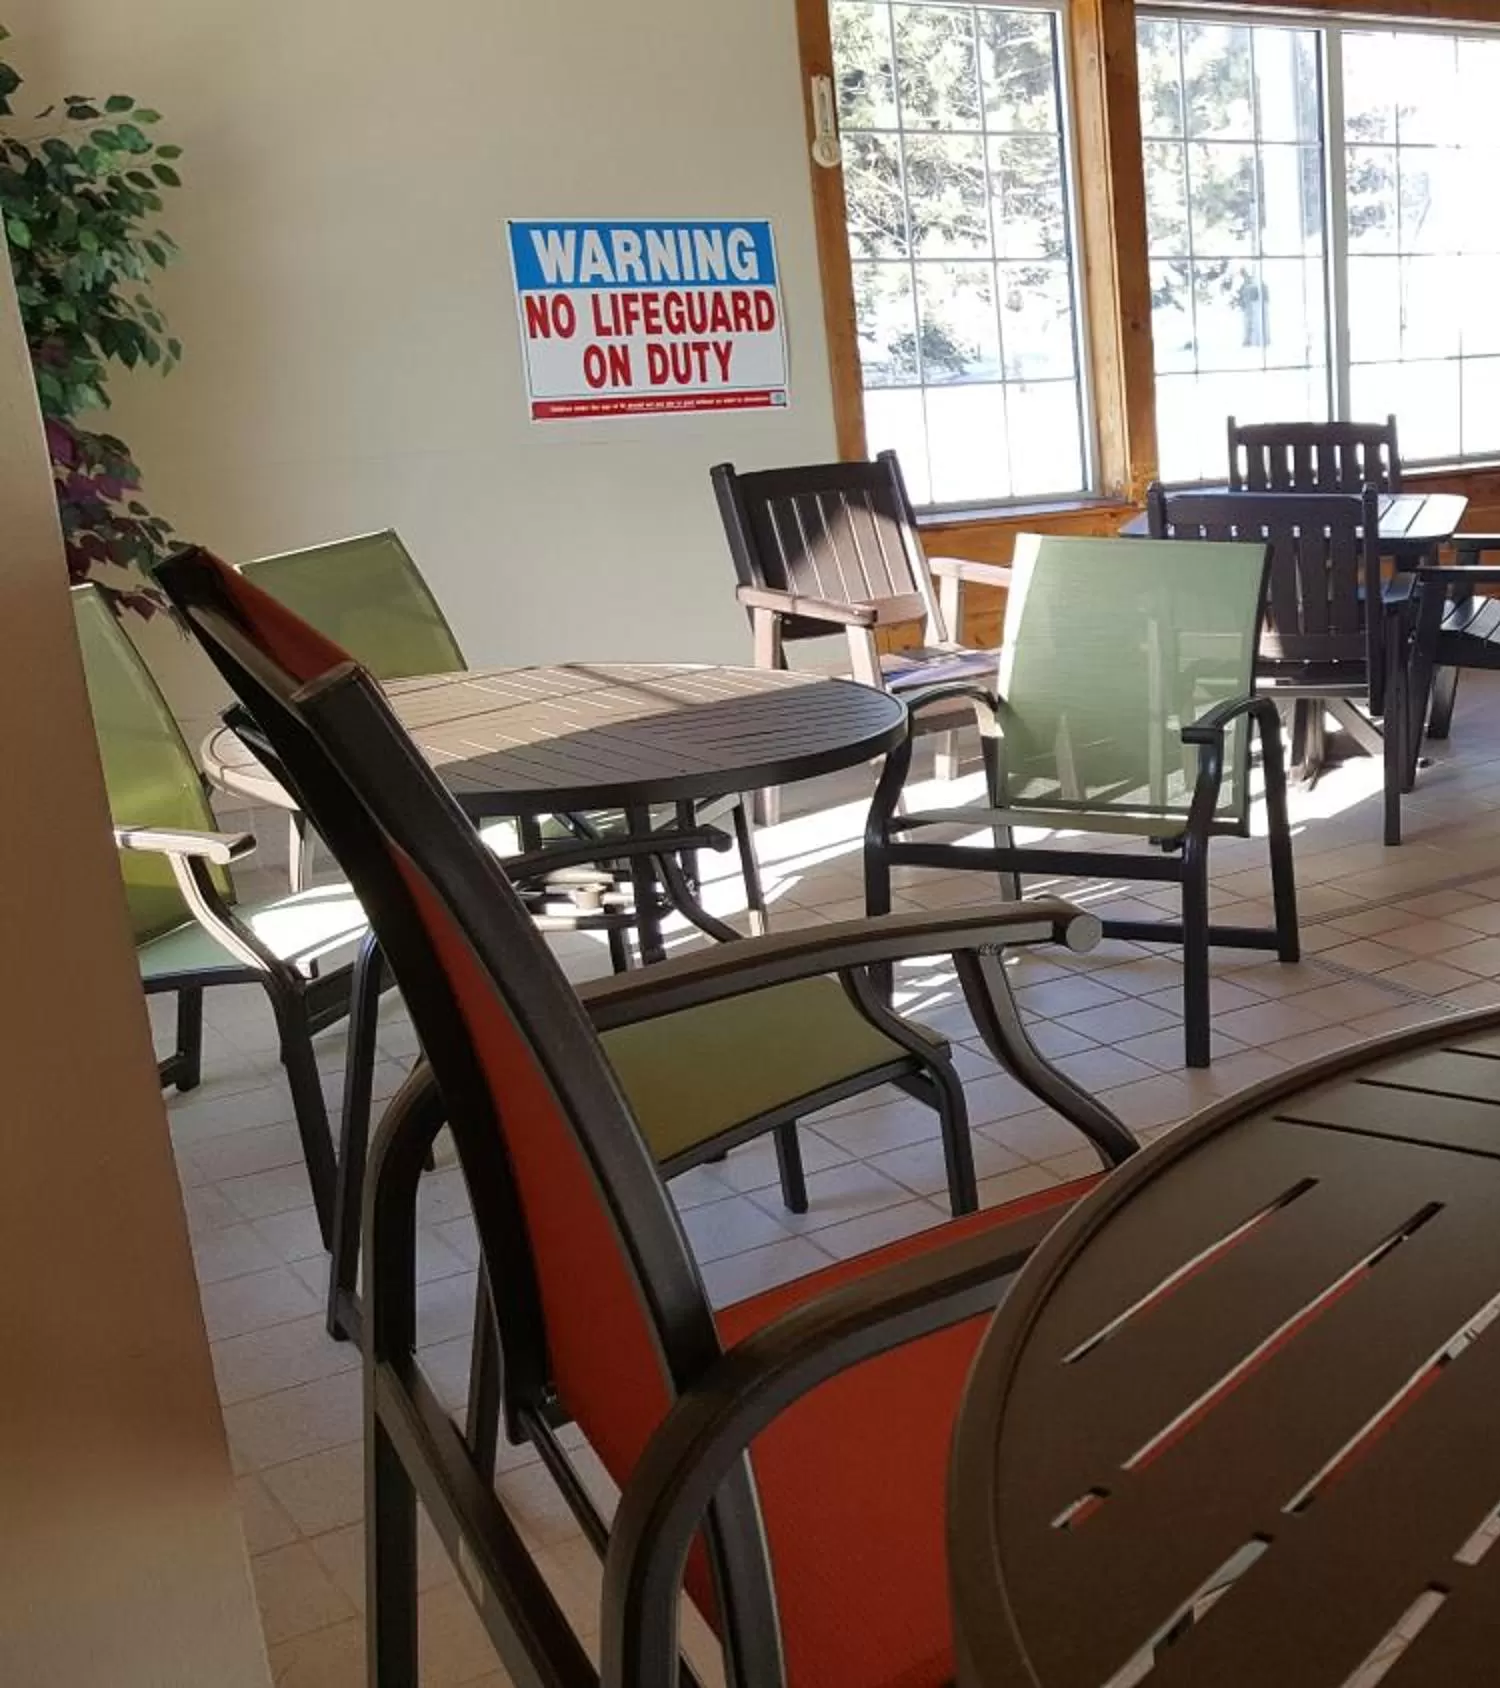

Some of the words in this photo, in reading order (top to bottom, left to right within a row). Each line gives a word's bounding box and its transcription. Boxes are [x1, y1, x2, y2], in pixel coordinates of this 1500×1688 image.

[528, 227, 760, 284] WARNING
[524, 293, 577, 339] NO
[591, 289, 776, 337] LIFEGUARD
[583, 343, 633, 389] ON
[646, 340, 733, 386] DUTY
